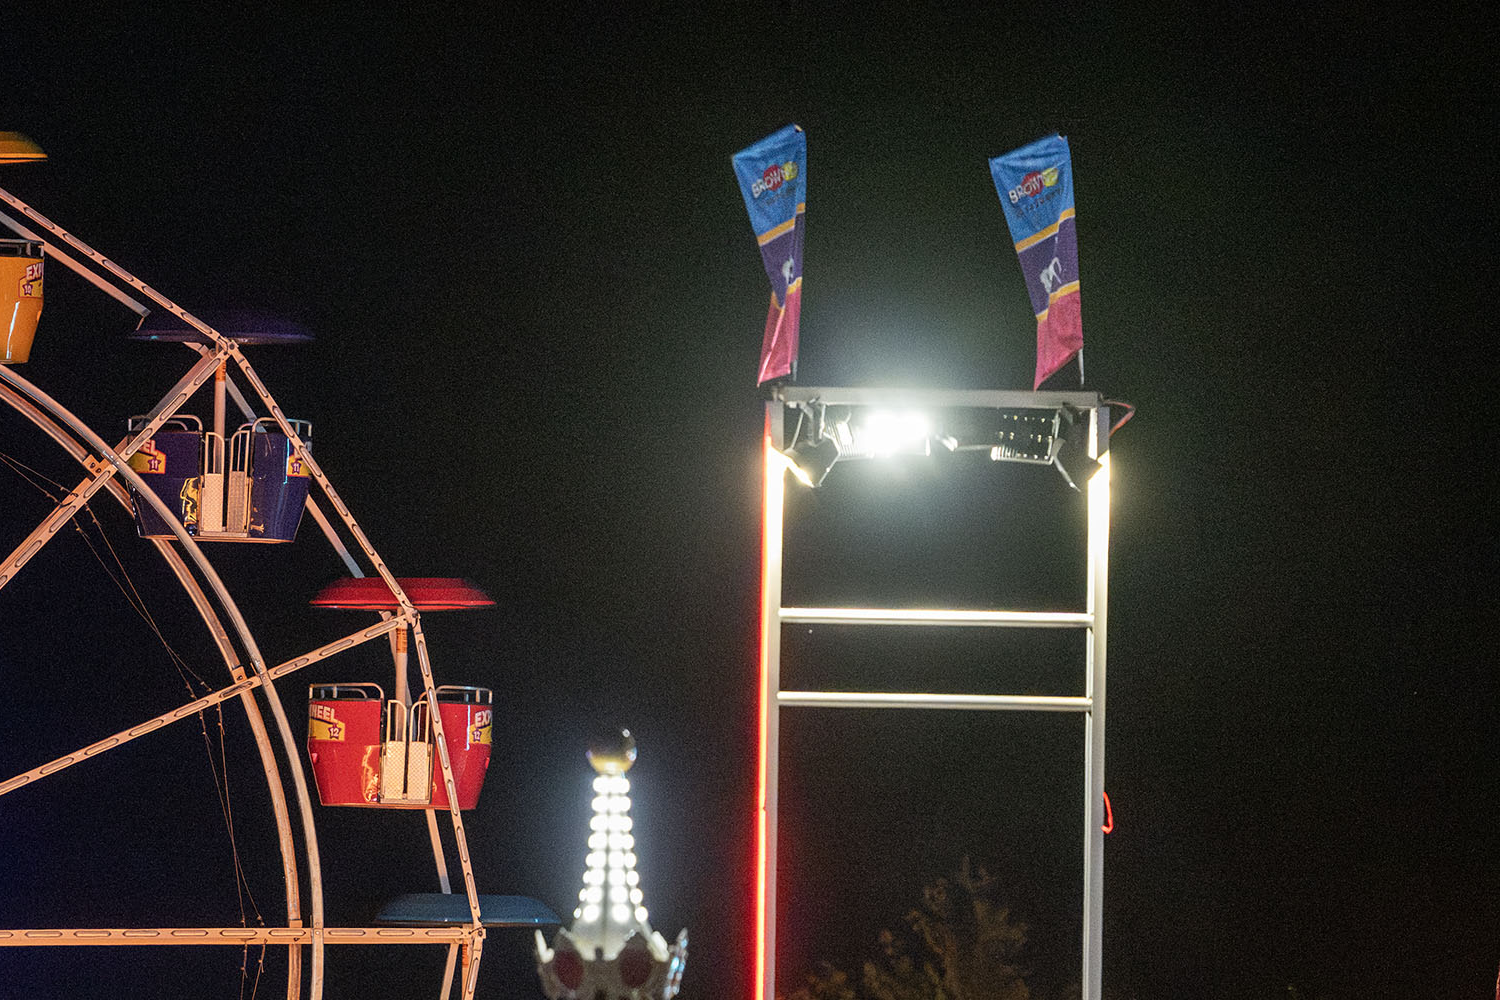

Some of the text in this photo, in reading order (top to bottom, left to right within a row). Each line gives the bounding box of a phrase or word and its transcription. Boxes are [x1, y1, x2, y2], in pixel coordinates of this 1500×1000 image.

[24, 285, 32, 294] 10
[151, 459, 159, 470] 11
[293, 463, 300, 472] 11
[329, 727, 340, 737] 12
[473, 731, 481, 740] 12
